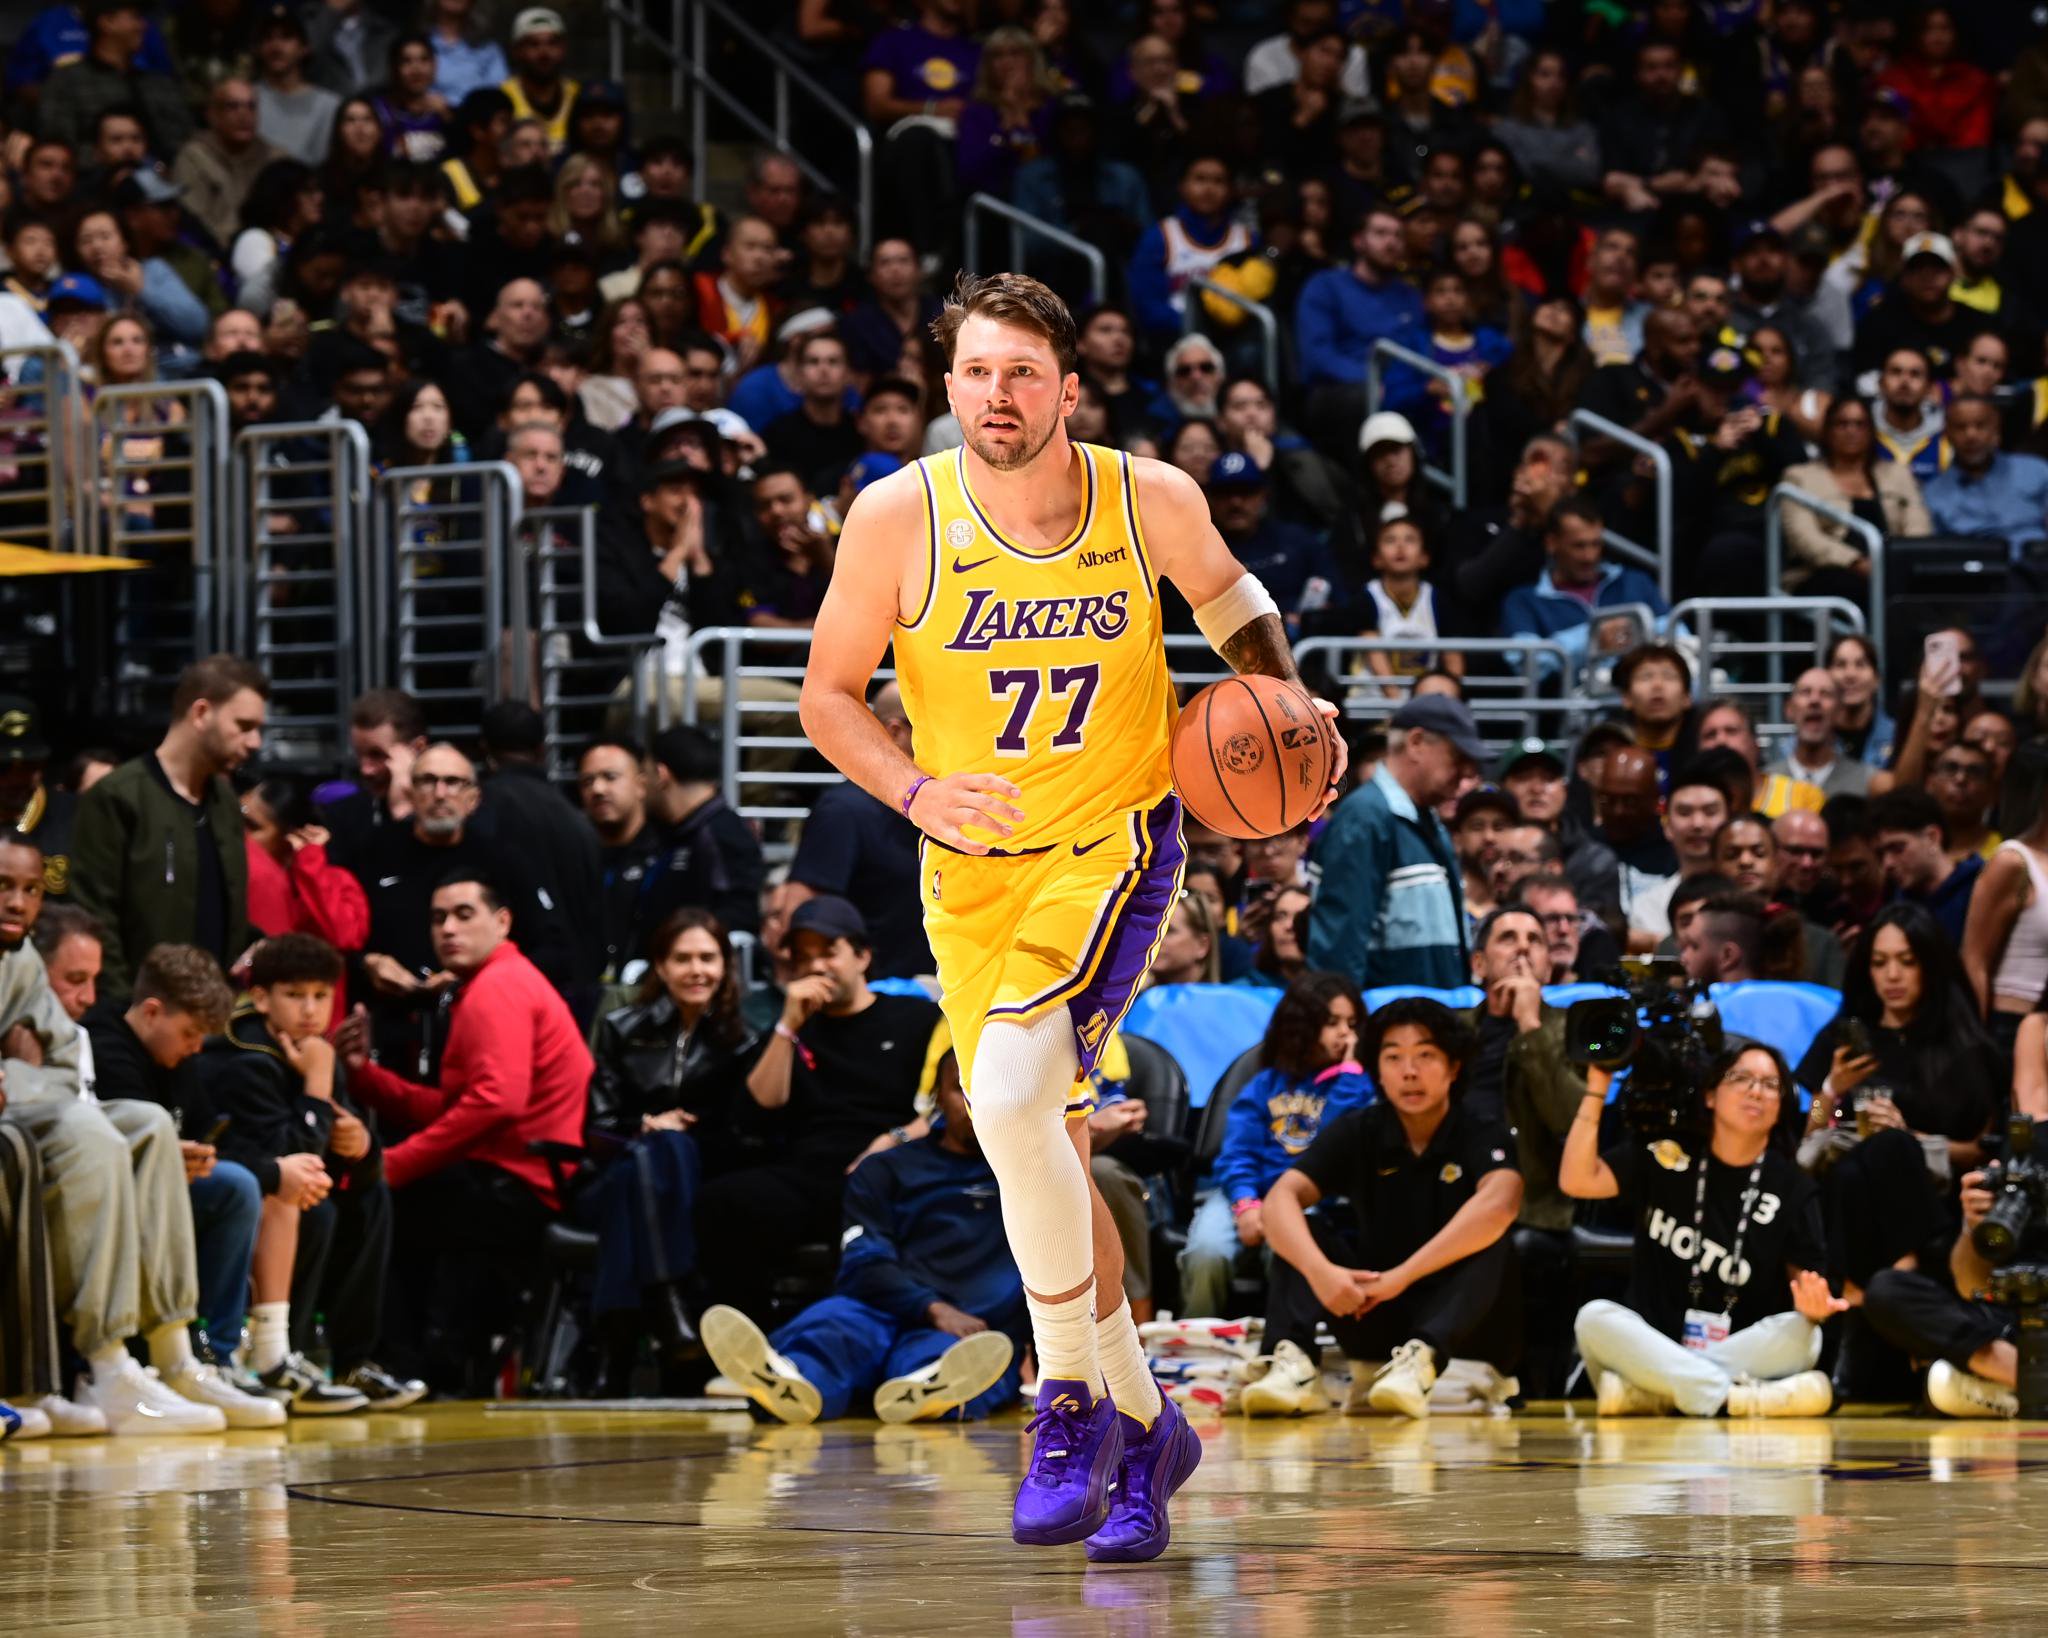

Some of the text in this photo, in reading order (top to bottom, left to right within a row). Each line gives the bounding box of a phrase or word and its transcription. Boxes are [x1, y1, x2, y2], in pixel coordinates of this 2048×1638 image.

[1077, 546, 1128, 569] Albert
[943, 588, 1130, 652] LAKERS
[988, 661, 1101, 758] 77
